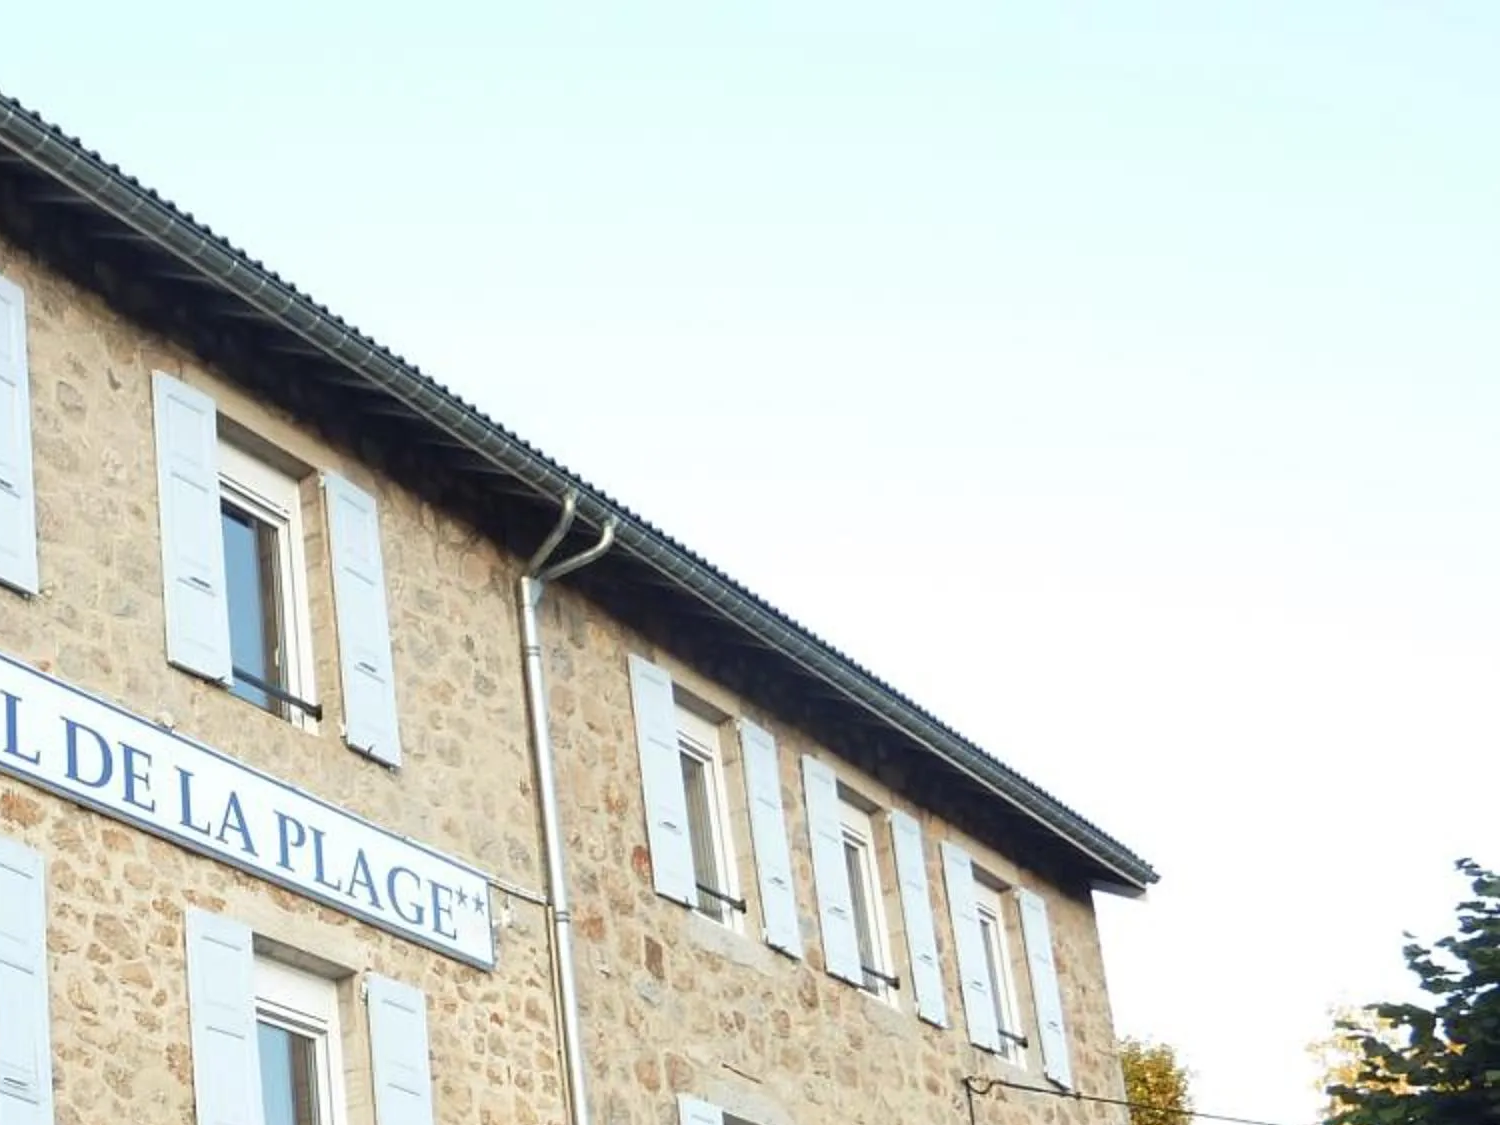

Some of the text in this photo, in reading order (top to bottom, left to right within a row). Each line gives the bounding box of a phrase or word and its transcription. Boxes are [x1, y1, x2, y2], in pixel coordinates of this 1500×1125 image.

[60, 715, 156, 813] DE
[175, 767, 259, 857] LA
[274, 810, 459, 940] PLAGE
